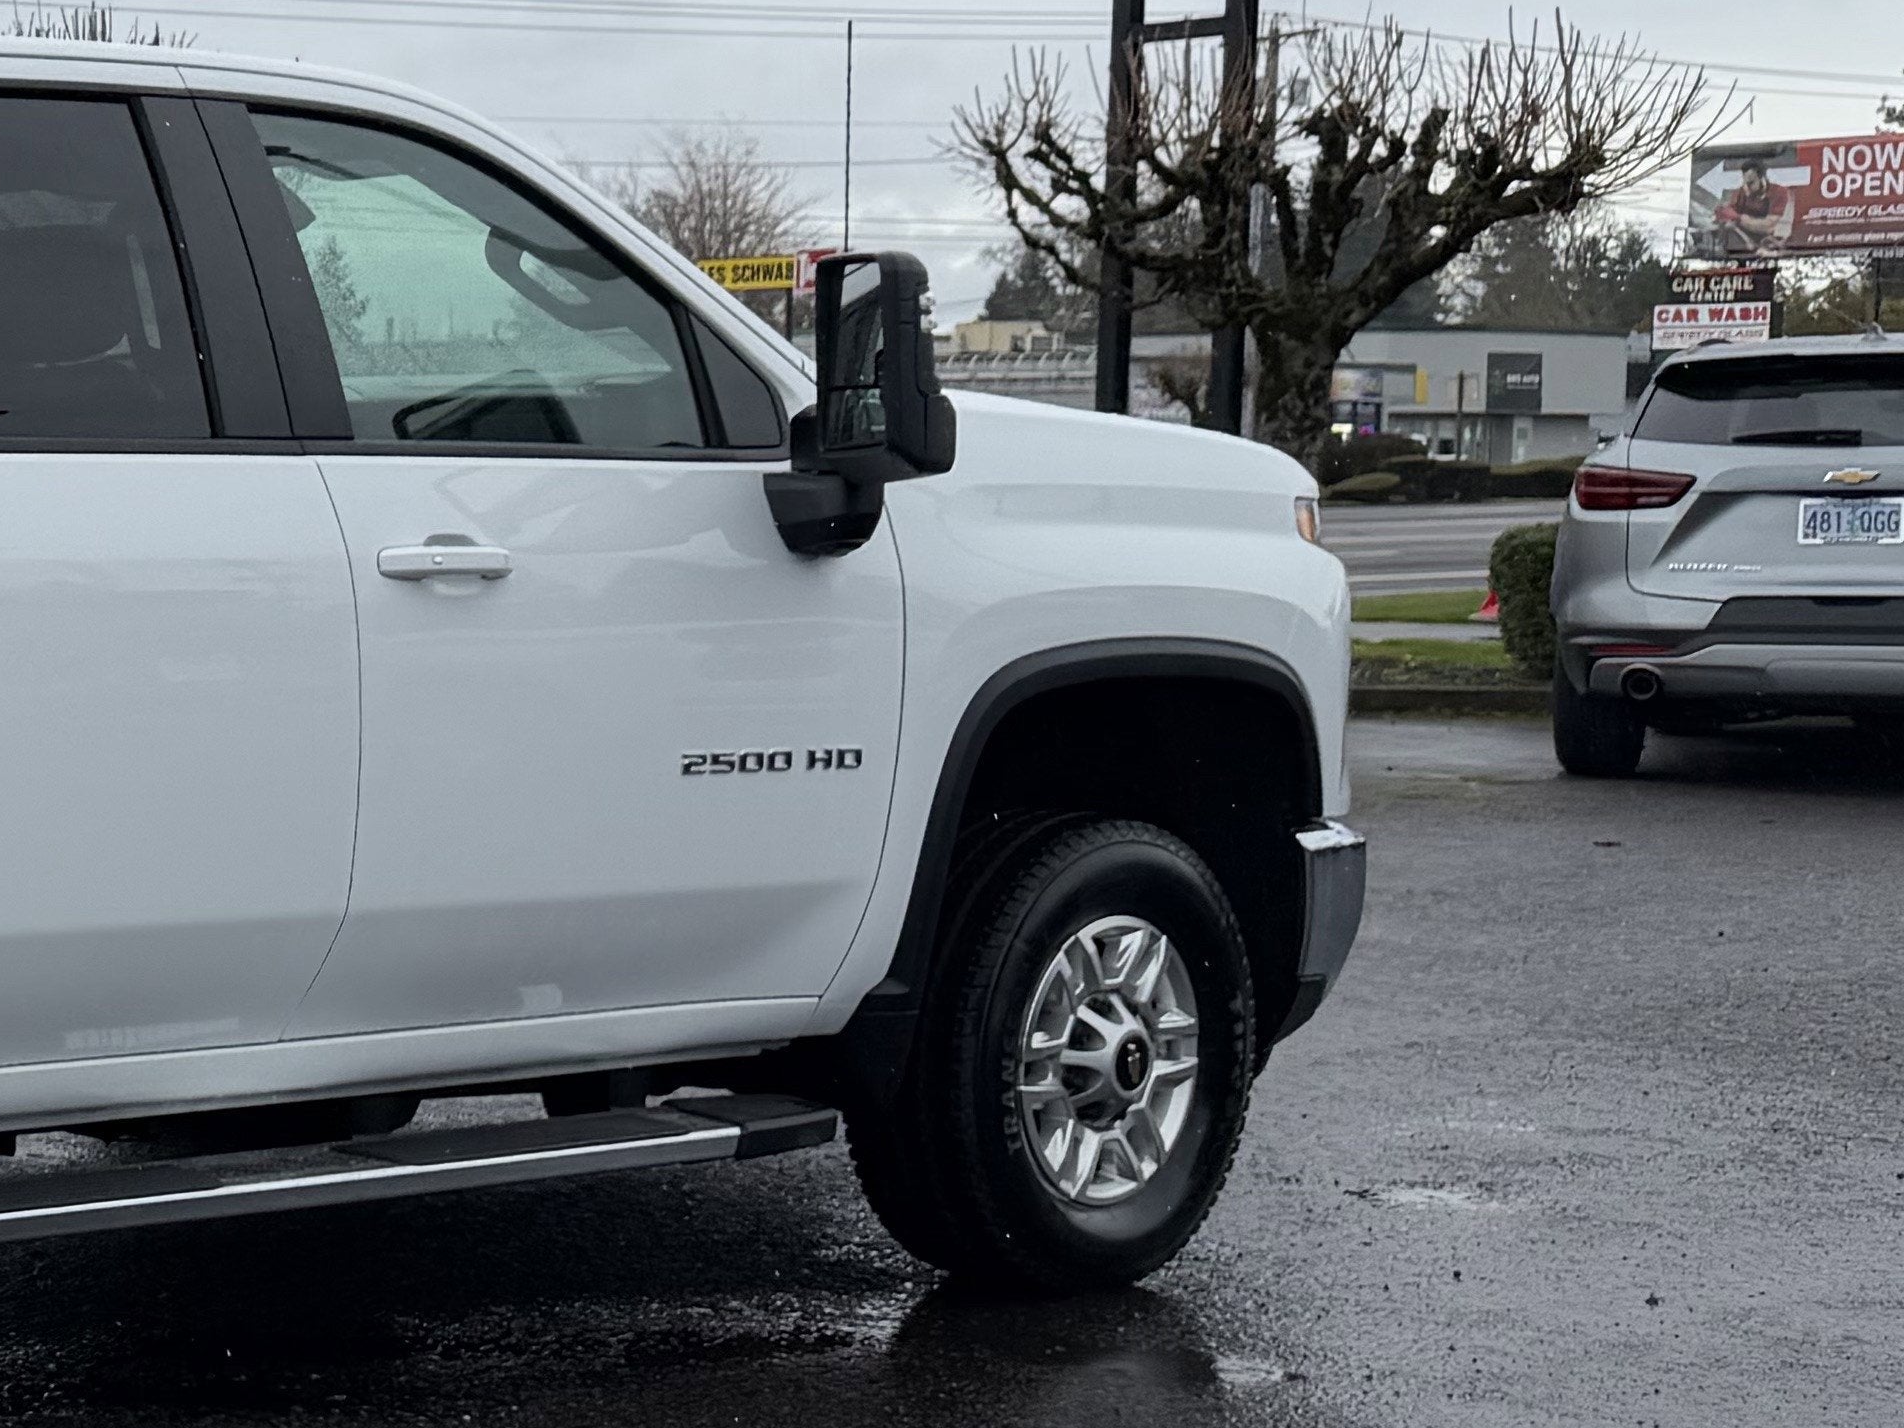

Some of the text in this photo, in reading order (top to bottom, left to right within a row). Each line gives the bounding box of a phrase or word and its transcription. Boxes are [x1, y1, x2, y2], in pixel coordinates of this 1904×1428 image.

[1822, 141, 1904, 173] NOW
[1820, 170, 1904, 199] OPEN
[1672, 273, 1754, 293] CAR CARE
[1657, 306, 1768, 323] CAR WASH
[1805, 510, 1842, 533] 481
[681, 747, 863, 776] 2500 HD
